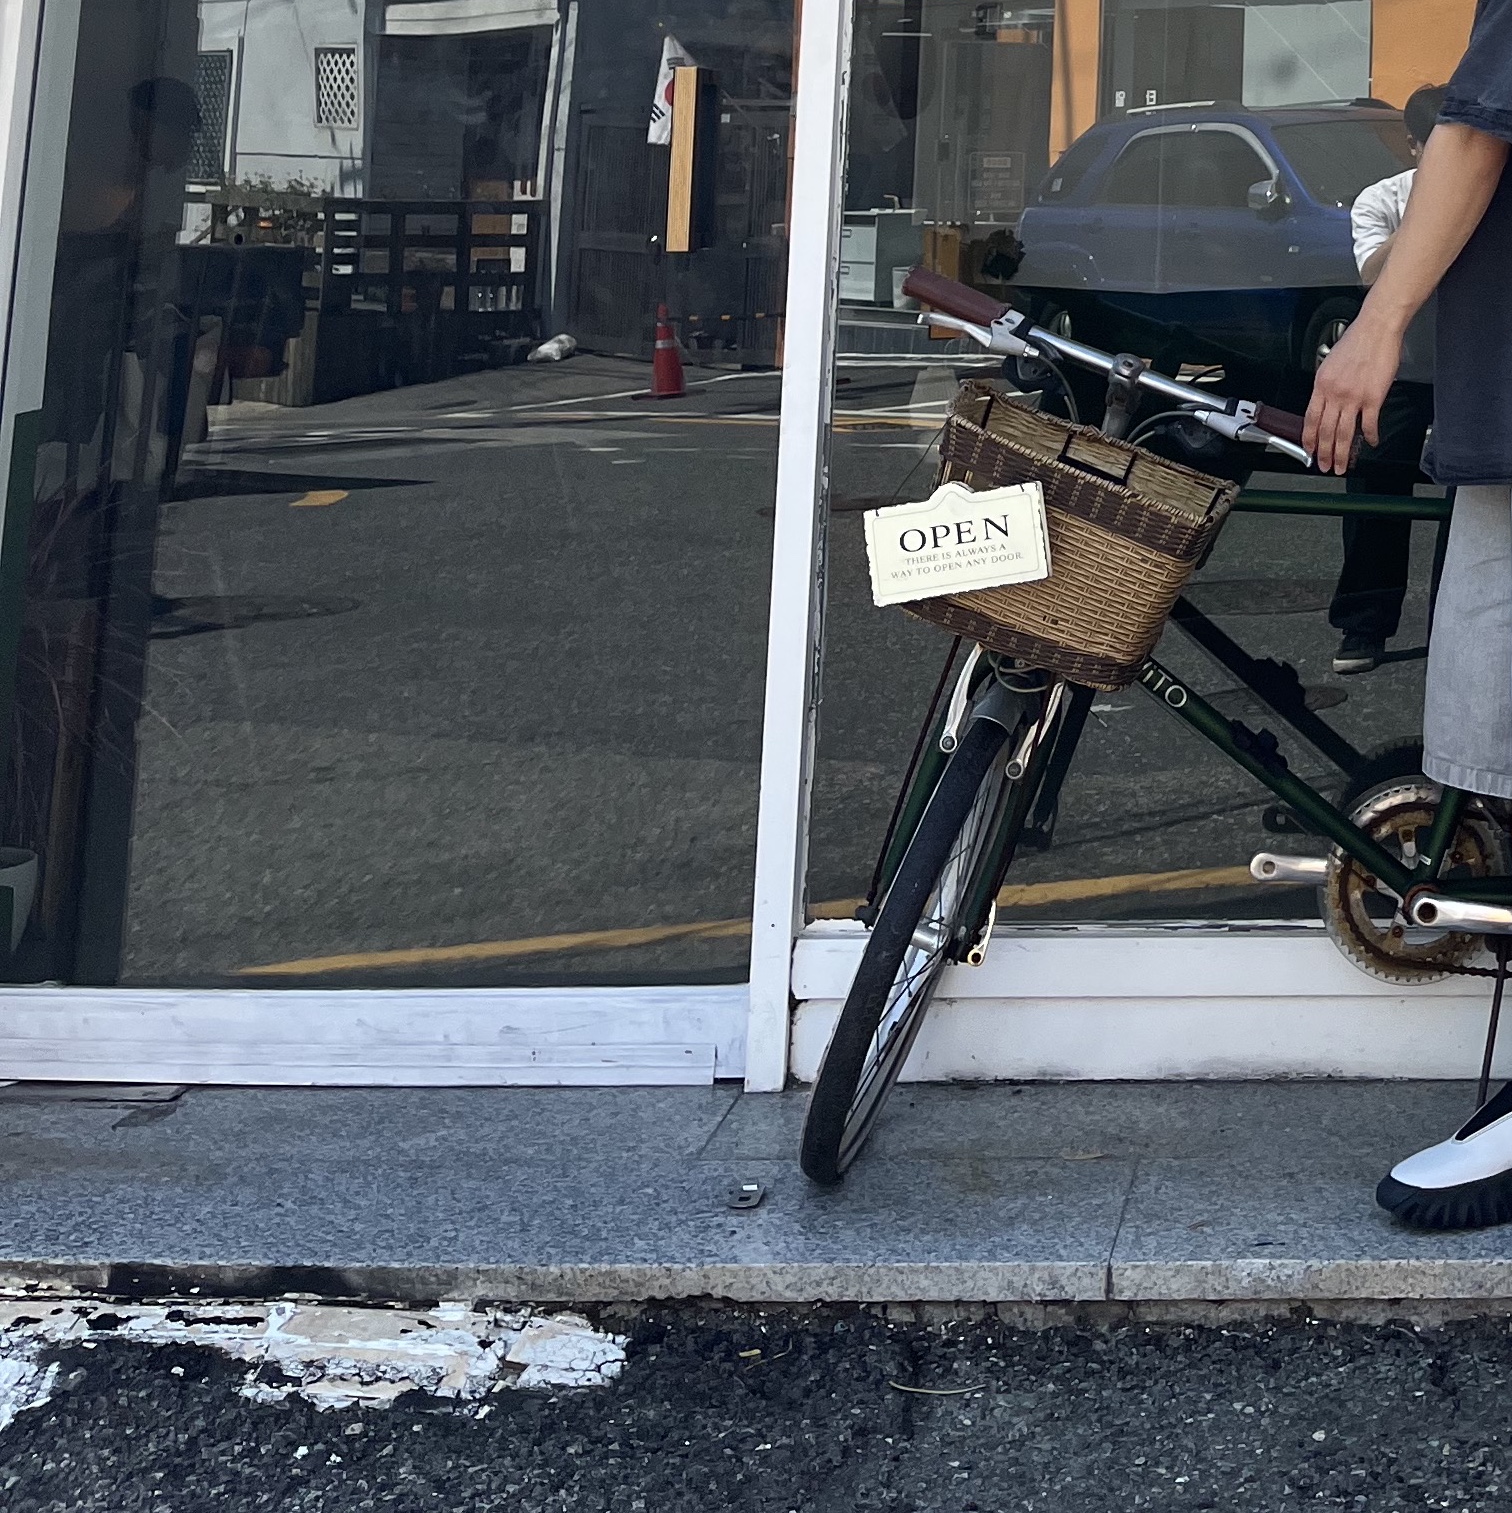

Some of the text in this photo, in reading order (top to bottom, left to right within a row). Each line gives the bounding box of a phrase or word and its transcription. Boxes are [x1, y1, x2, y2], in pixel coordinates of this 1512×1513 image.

[899, 514, 1010, 553] OPEN
[905, 554, 938, 565] THERE
[942, 552, 951, 560] IS
[955, 545, 996, 558] ALWAYS
[891, 569, 912, 579] WAY
[916, 567, 931, 575] TO
[933, 562, 962, 573] OPEN
[966, 557, 987, 568] ANY
